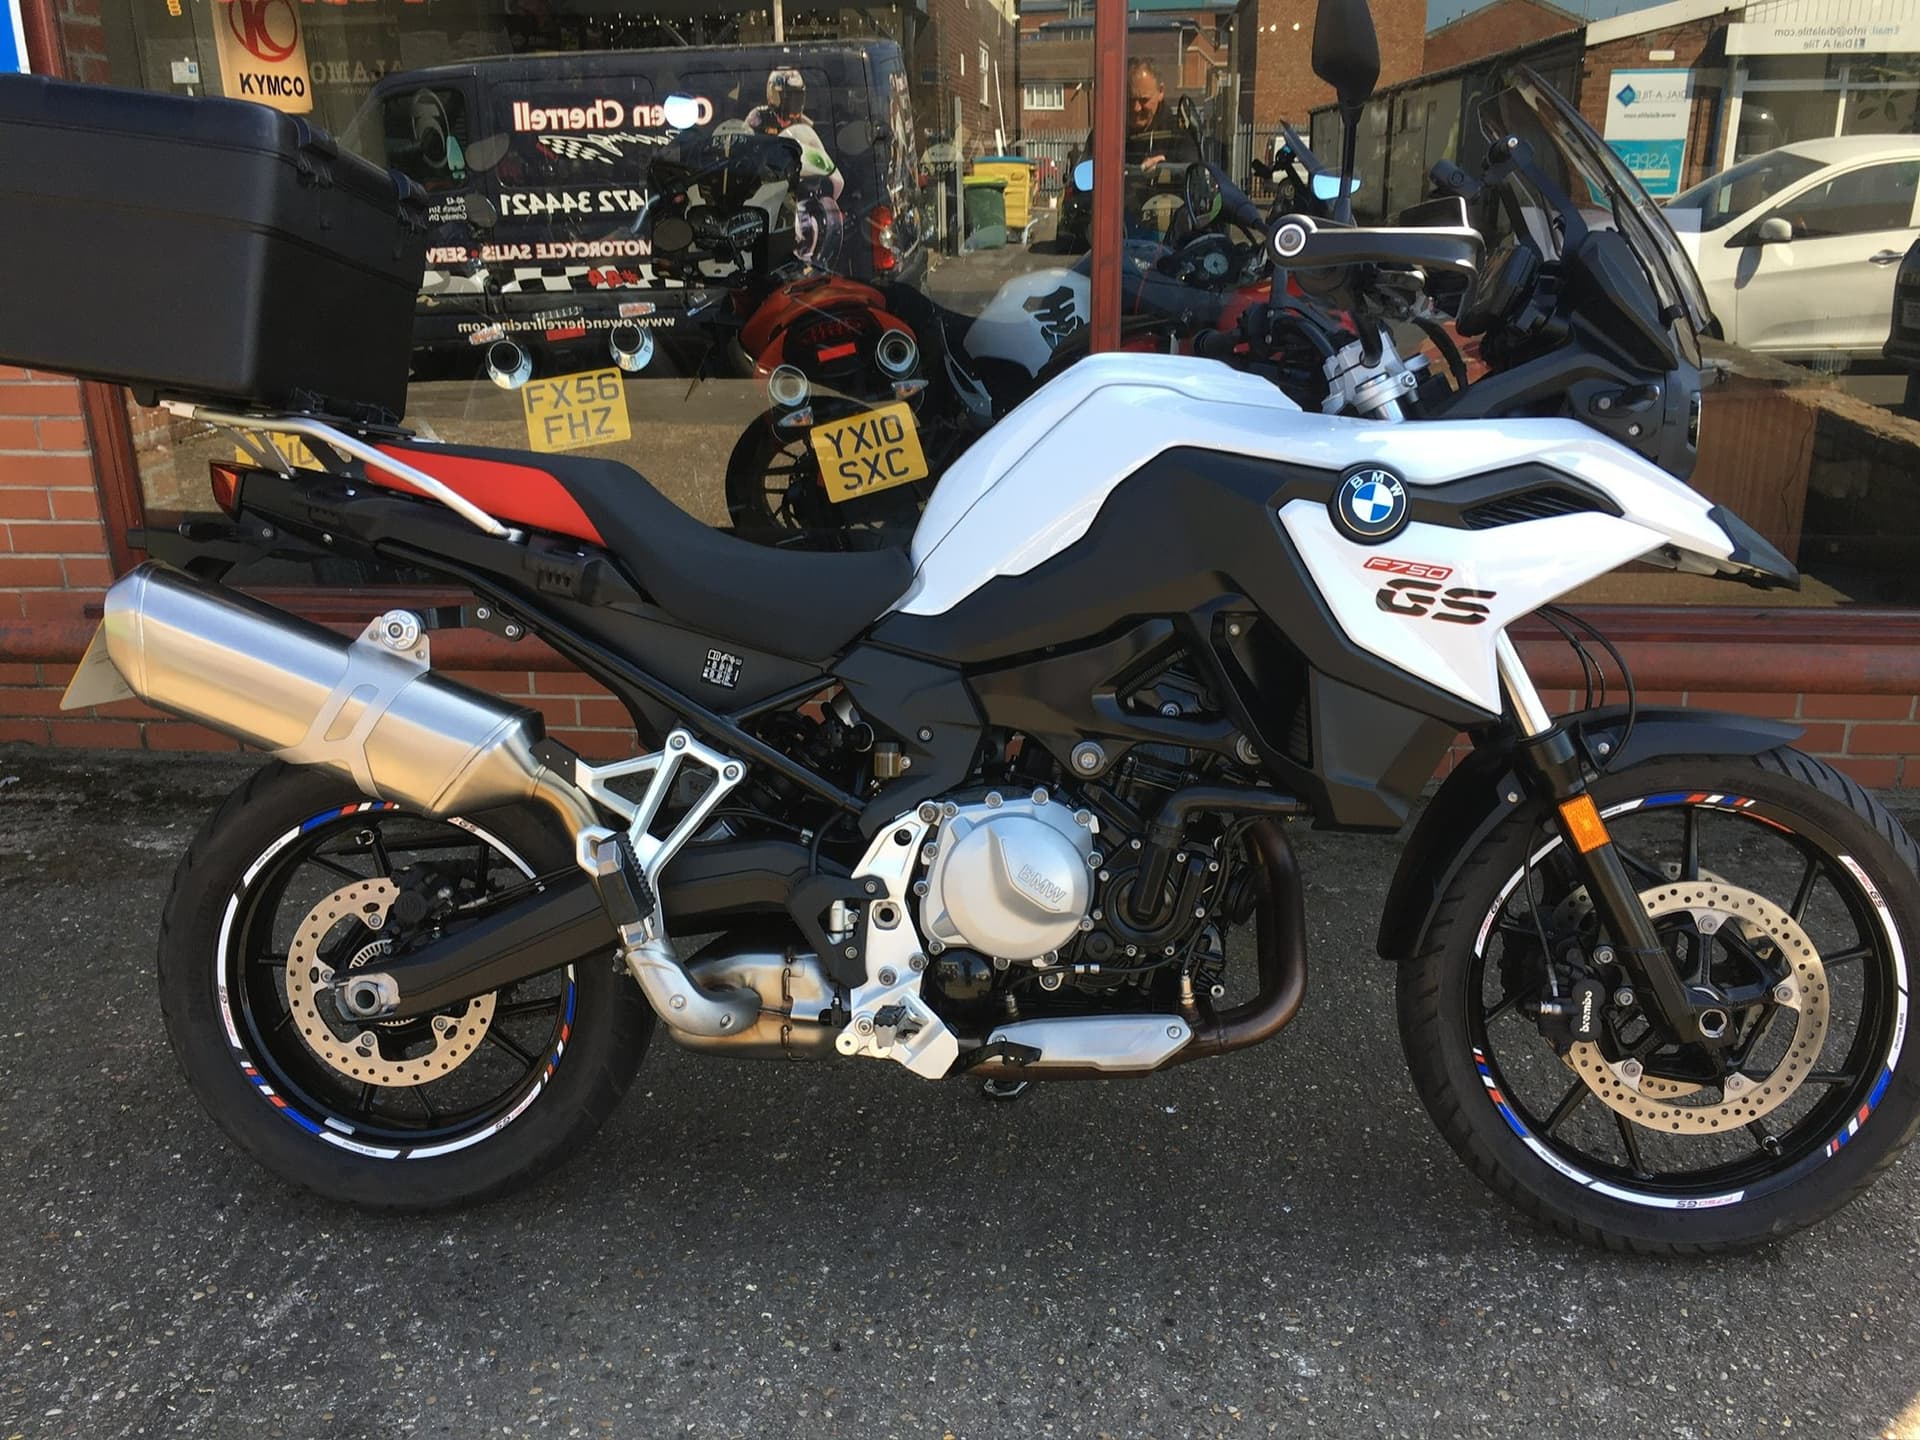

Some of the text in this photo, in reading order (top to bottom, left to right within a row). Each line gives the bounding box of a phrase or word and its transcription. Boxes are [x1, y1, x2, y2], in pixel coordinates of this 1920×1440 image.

[239, 72, 305, 97] KYMCO
[527, 371, 620, 415] FX56
[543, 406, 615, 446] FHZ
[823, 413, 905, 460] YX10
[838, 447, 910, 492] SXC
[1350, 470, 1404, 498] BMW
[1366, 558, 1451, 580] F750
[1375, 578, 1497, 626] GS
[1018, 863, 1067, 903] BMW
[1870, 889, 1887, 909] GS
[1579, 990, 1593, 1033] brembo
[1675, 1200, 1698, 1210] GS
